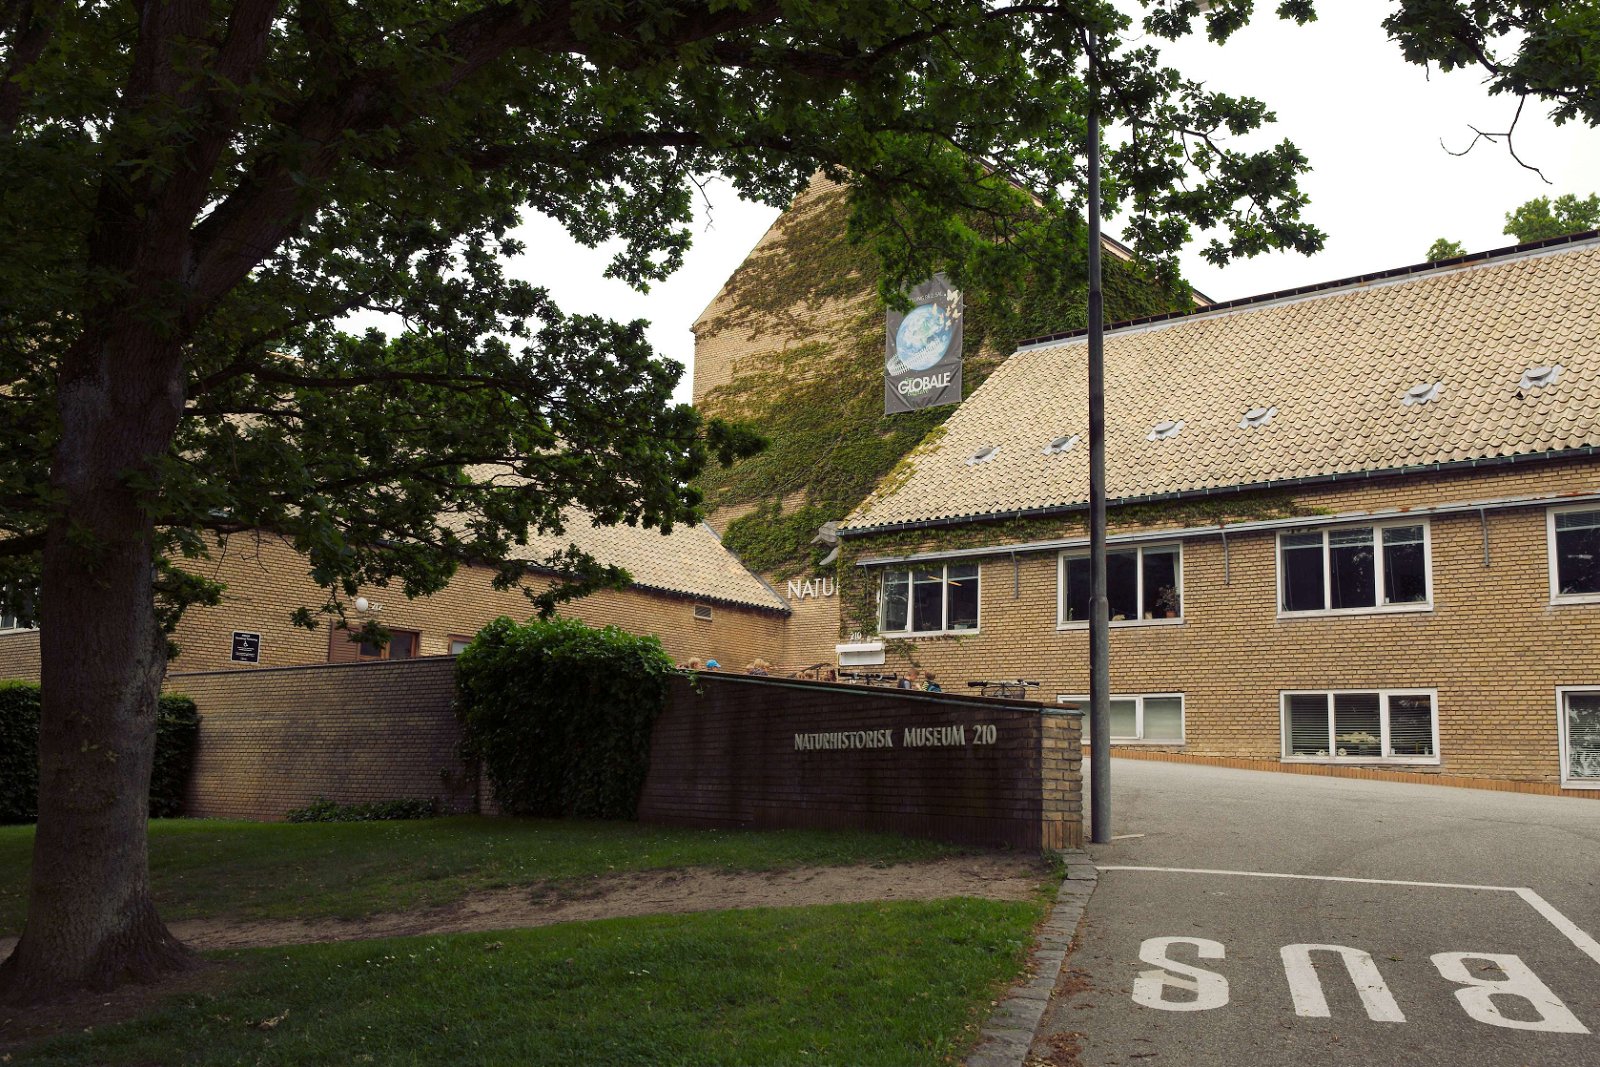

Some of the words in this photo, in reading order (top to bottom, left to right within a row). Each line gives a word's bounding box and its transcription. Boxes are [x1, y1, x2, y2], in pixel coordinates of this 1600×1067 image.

[898, 372, 951, 395] GLOBALE
[794, 729, 893, 750] NATURHISTORISK
[903, 724, 966, 748] MUSEUM
[972, 724, 997, 745] 210
[1131, 936, 1591, 1034] BUS
